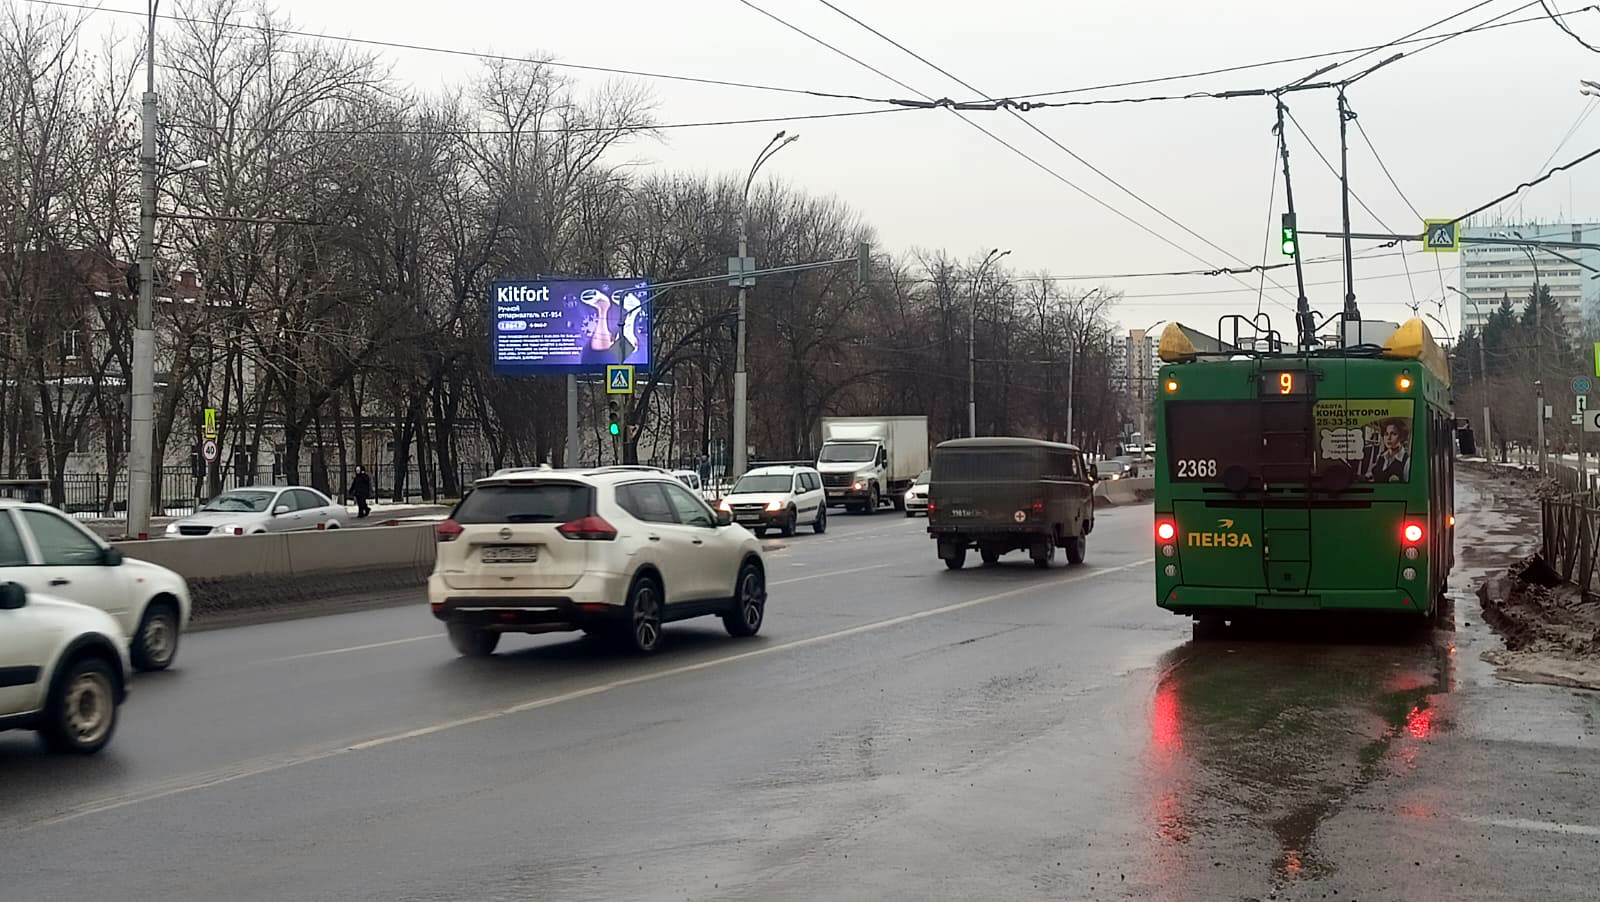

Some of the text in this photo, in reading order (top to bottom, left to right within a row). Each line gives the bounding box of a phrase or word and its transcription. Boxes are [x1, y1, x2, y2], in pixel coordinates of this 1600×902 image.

[497, 286, 549, 302] Kitfort
[1280, 373, 1292, 394] 9
[1316, 409, 1389, 417] КОНДУКТОРОМ
[205, 445, 215, 455] 40
[1177, 459, 1217, 477] 2368
[1188, 532, 1253, 548] ПЕНЗА
